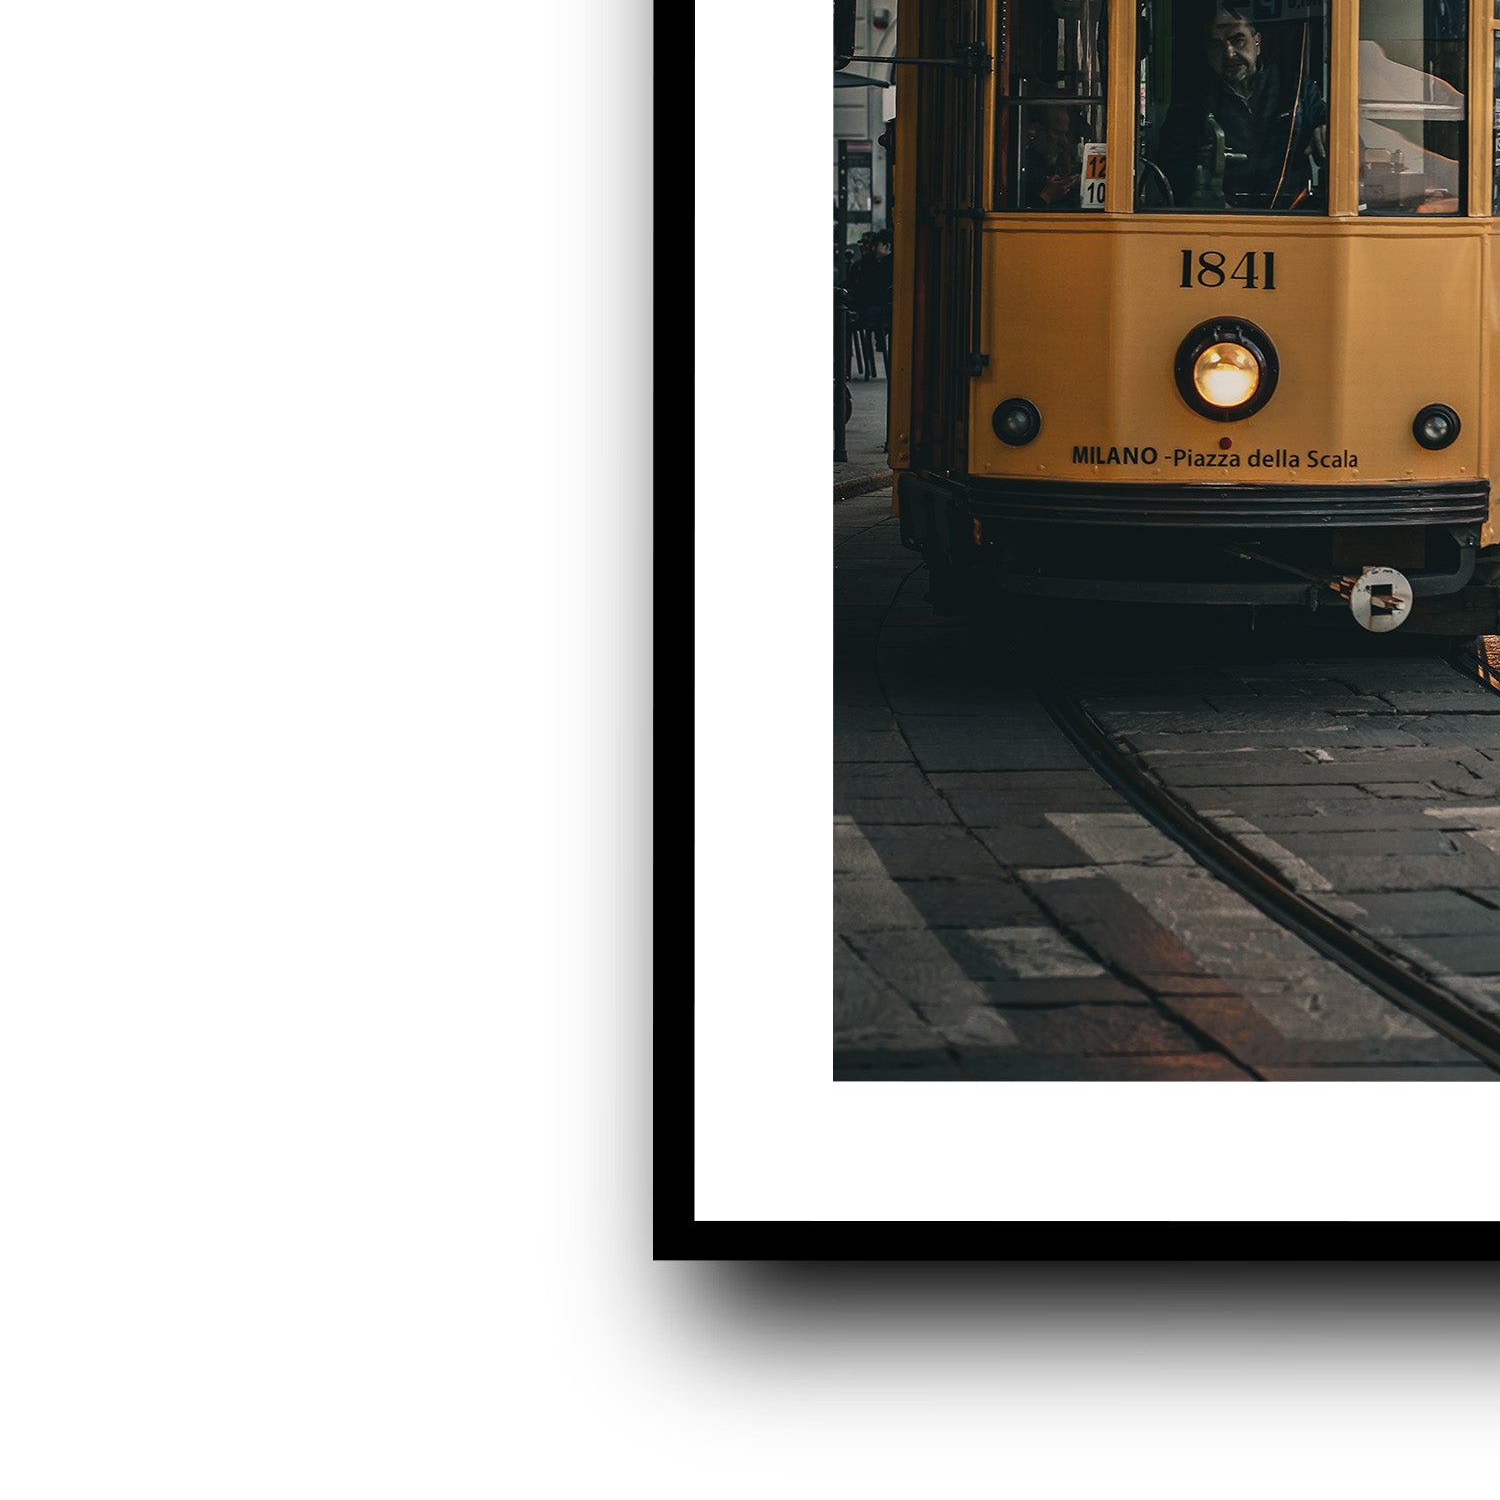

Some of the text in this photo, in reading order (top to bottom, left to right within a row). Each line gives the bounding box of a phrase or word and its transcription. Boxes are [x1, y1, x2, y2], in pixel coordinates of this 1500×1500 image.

[1089, 156, 1106, 178] 12
[1087, 182, 1106, 204] 10
[1179, 249, 1276, 290] 1841
[1072, 446, 1158, 465] MILANO
[1247, 449, 1300, 468] della
[1307, 450, 1359, 469] Scala
